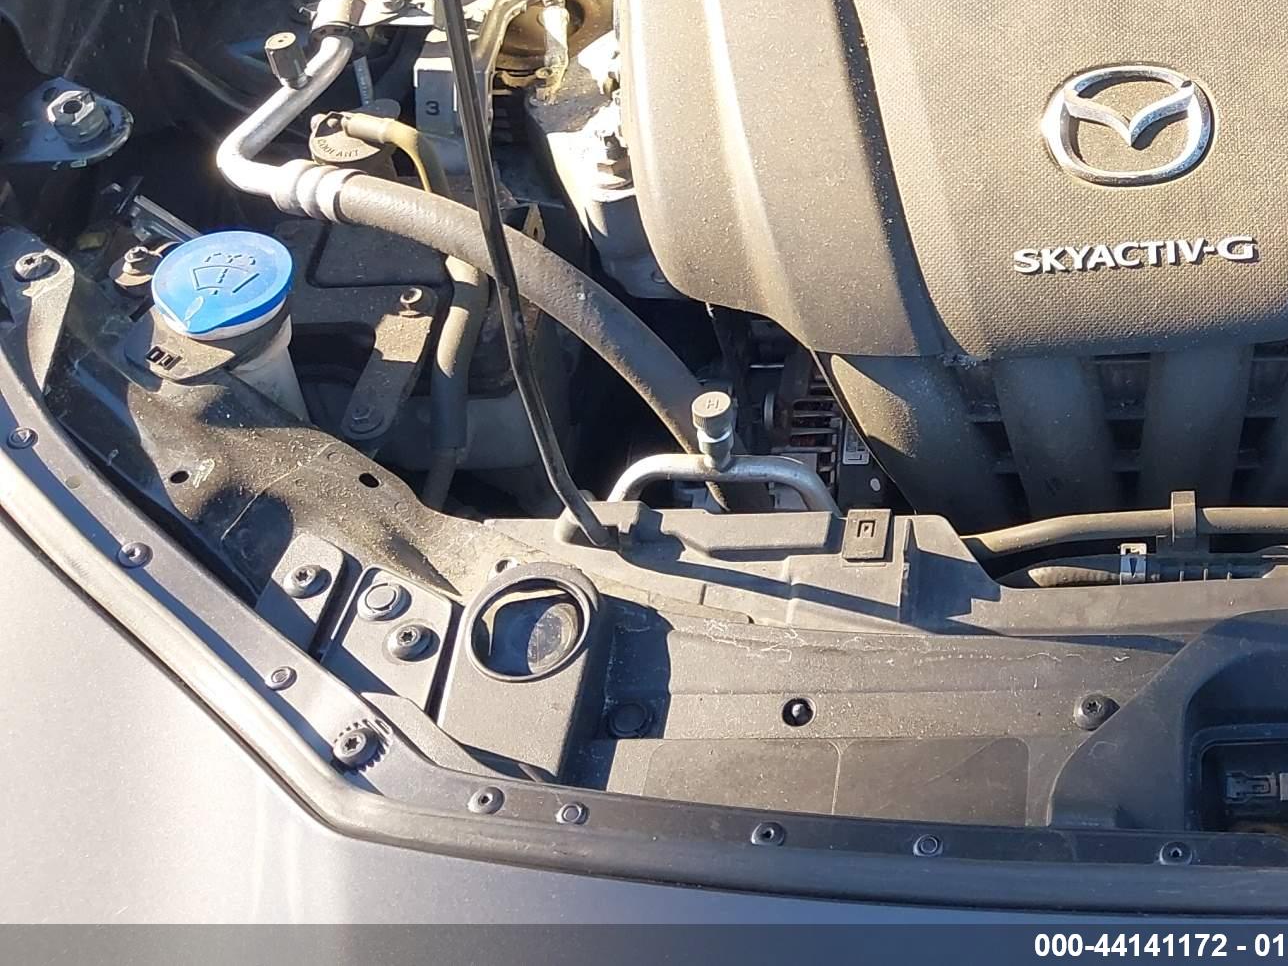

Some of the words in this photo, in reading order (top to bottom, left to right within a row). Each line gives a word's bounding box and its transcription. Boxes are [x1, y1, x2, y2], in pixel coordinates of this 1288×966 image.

[426, 100, 440, 116] 3
[317, 138, 359, 158] COOLANT
[1013, 235, 1258, 275] SKYACTIV-G
